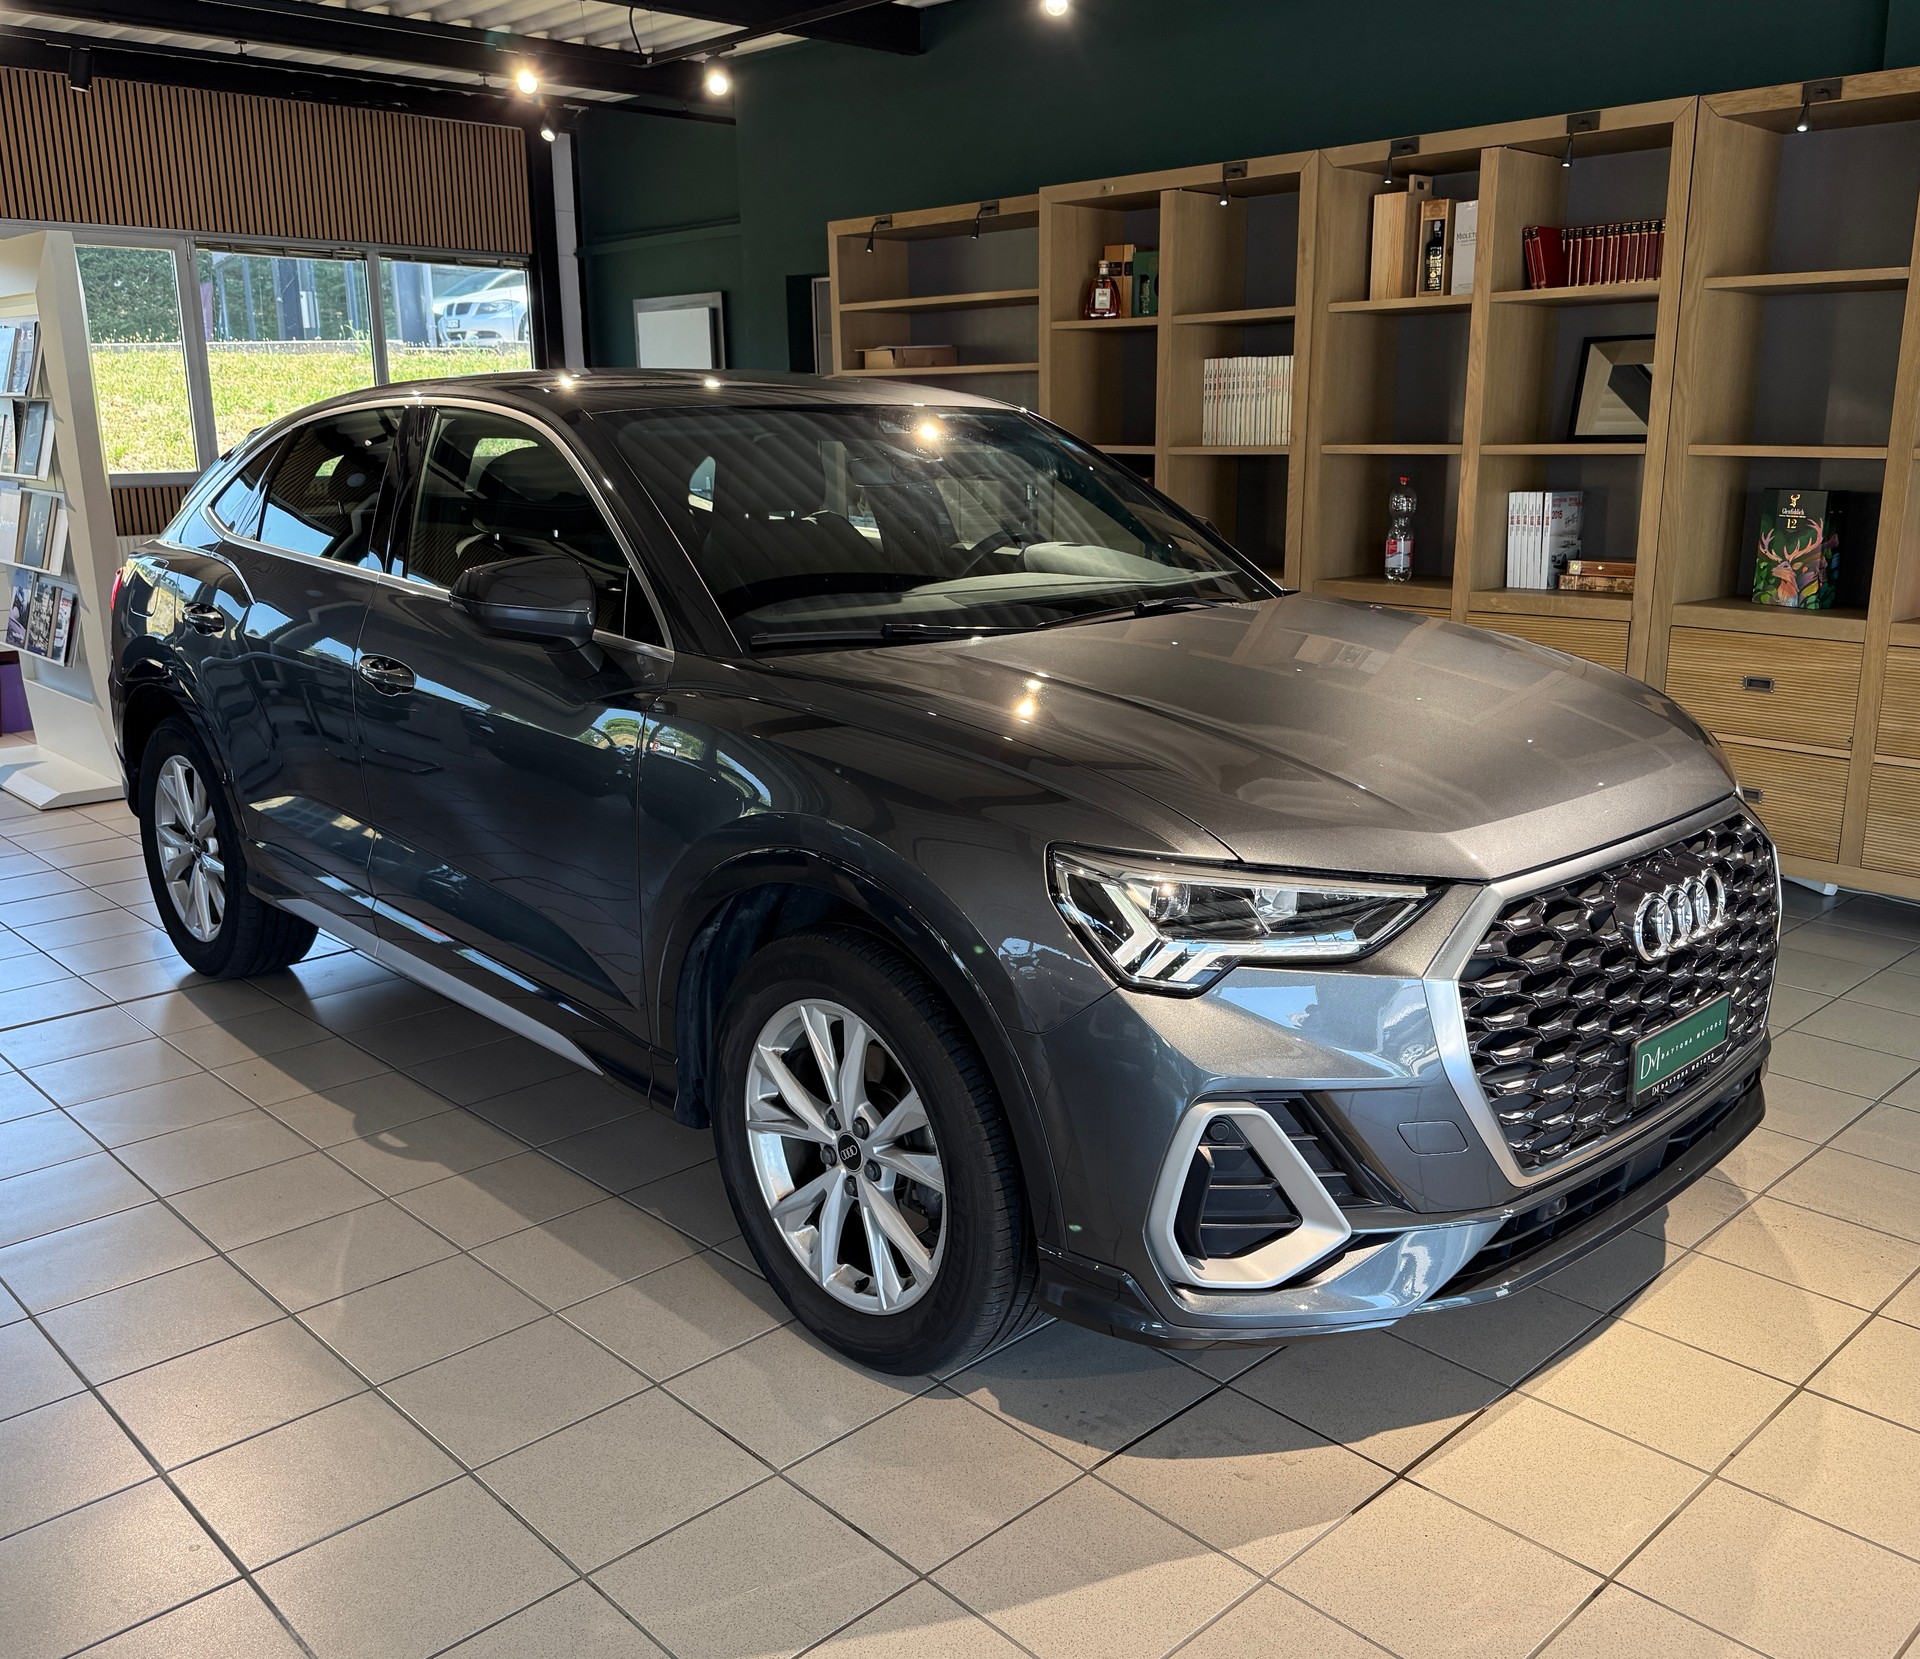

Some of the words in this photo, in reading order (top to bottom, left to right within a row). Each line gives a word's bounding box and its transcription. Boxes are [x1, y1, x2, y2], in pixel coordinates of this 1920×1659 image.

[1786, 518, 1797, 528] 12
[1661, 1037, 1693, 1060] DAYTONA
[1696, 1019, 1722, 1039] MOTORS
[1691, 1052, 1715, 1071] MOTORS
